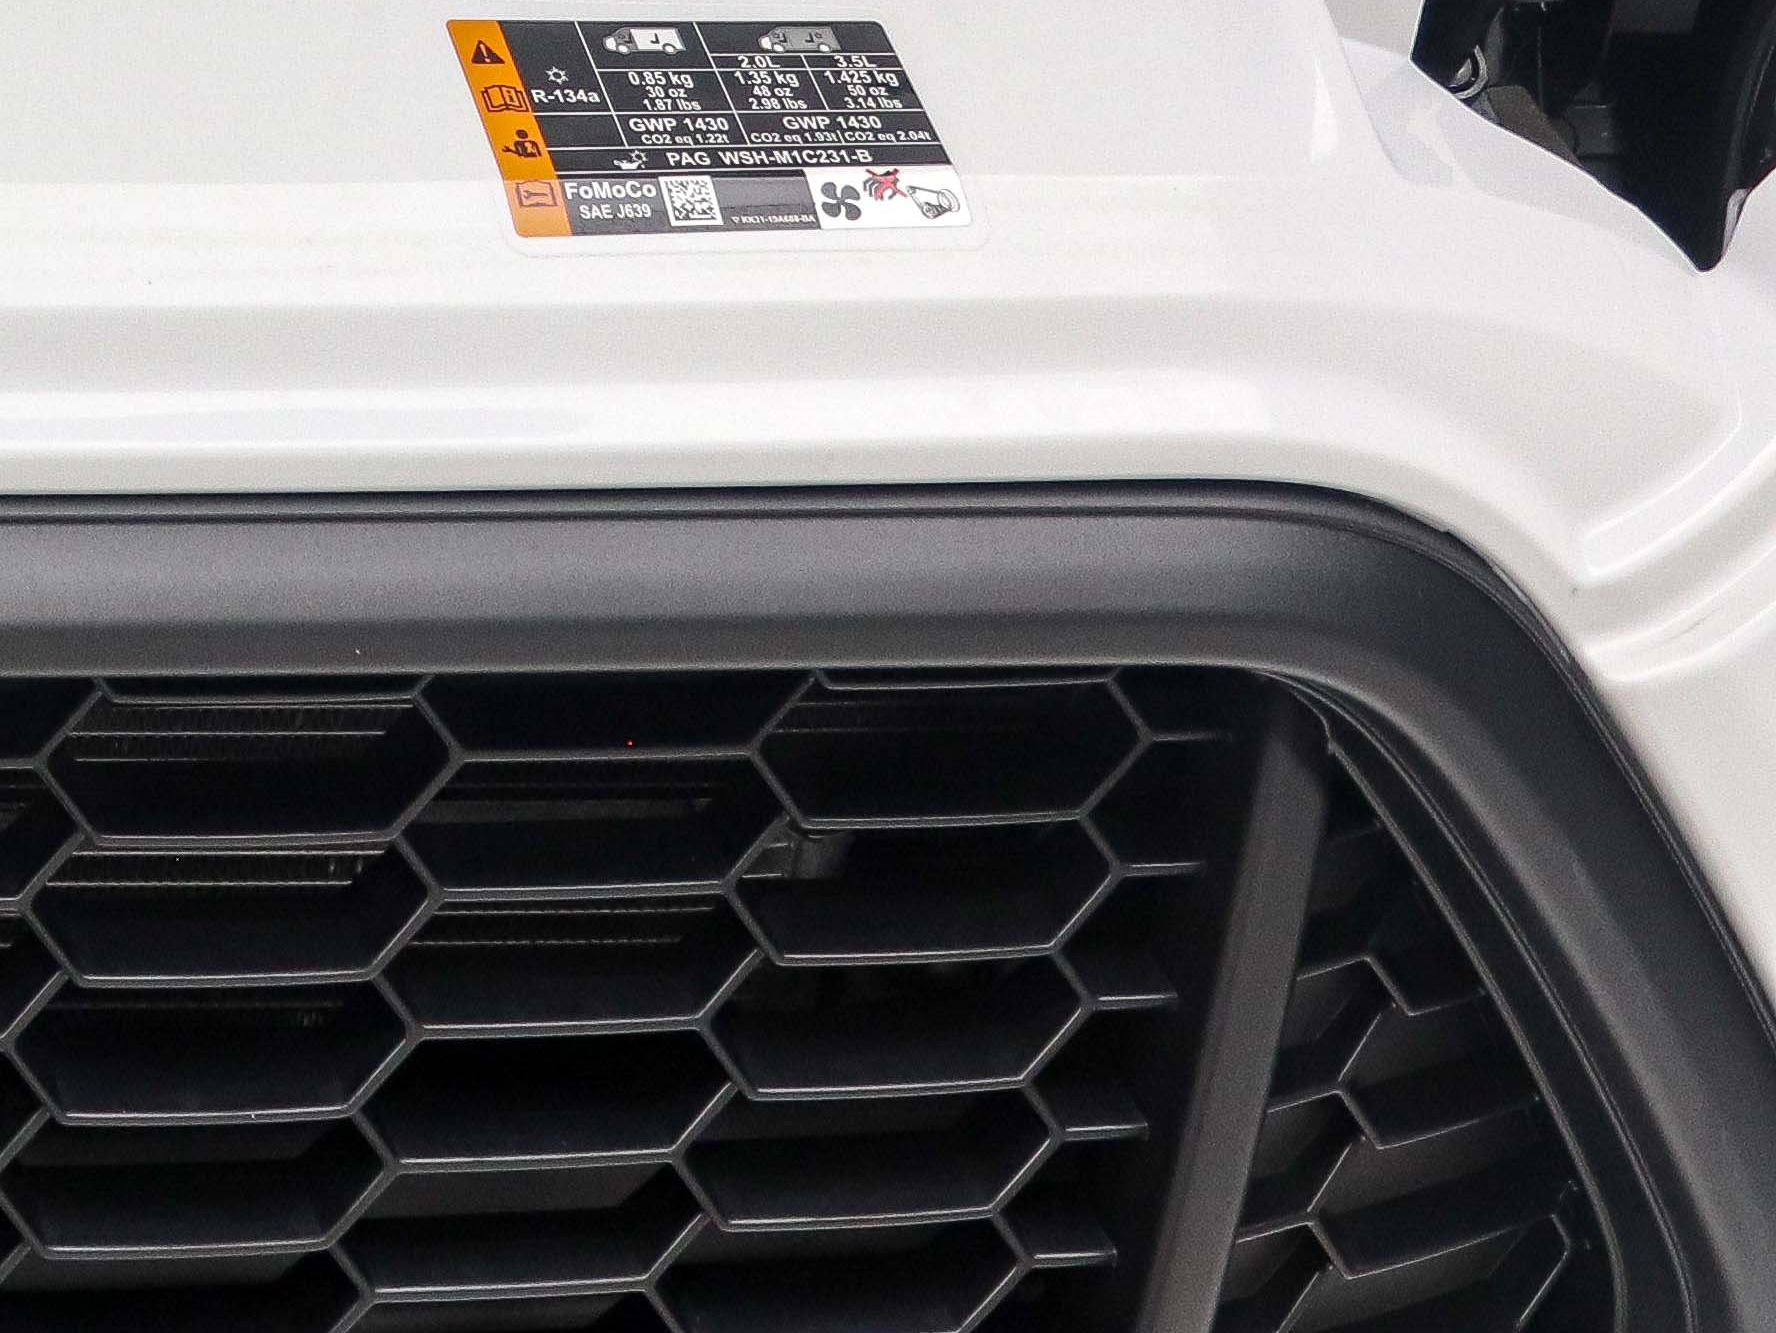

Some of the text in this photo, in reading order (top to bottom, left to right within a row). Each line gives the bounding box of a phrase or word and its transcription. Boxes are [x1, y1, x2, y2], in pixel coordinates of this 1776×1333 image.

[738, 55, 780, 68] 2.0L
[834, 55, 877, 67] 3.5L
[628, 71, 694, 89] 0.85 kg
[734, 70, 799, 87] 1.35 kg
[824, 69, 900, 87] 1.425 kg
[530, 89, 600, 103] R-134a
[646, 87, 688, 97] 30 oz
[752, 86, 794, 97] 48 oz
[847, 85, 889, 96] 50 oz
[643, 99, 702, 111] 1.87 lbs
[748, 97, 808, 110] 2.98 lbs
[844, 97, 902, 109] 3.14 lbs
[628, 117, 729, 132] GWP 1430
[782, 115, 882, 130] GWP 1430
[641, 133, 730, 147] CO2 eq 1.22t
[750, 133, 782, 143] CO2
[784, 135, 803, 145] eq
[844, 132, 876, 142] CO2
[878, 134, 896, 145] eq
[665, 150, 873, 167] PAG WSH-M1C231-B
[565, 181, 657, 199] FoMoCo
[580, 203, 652, 219] SAE J639
